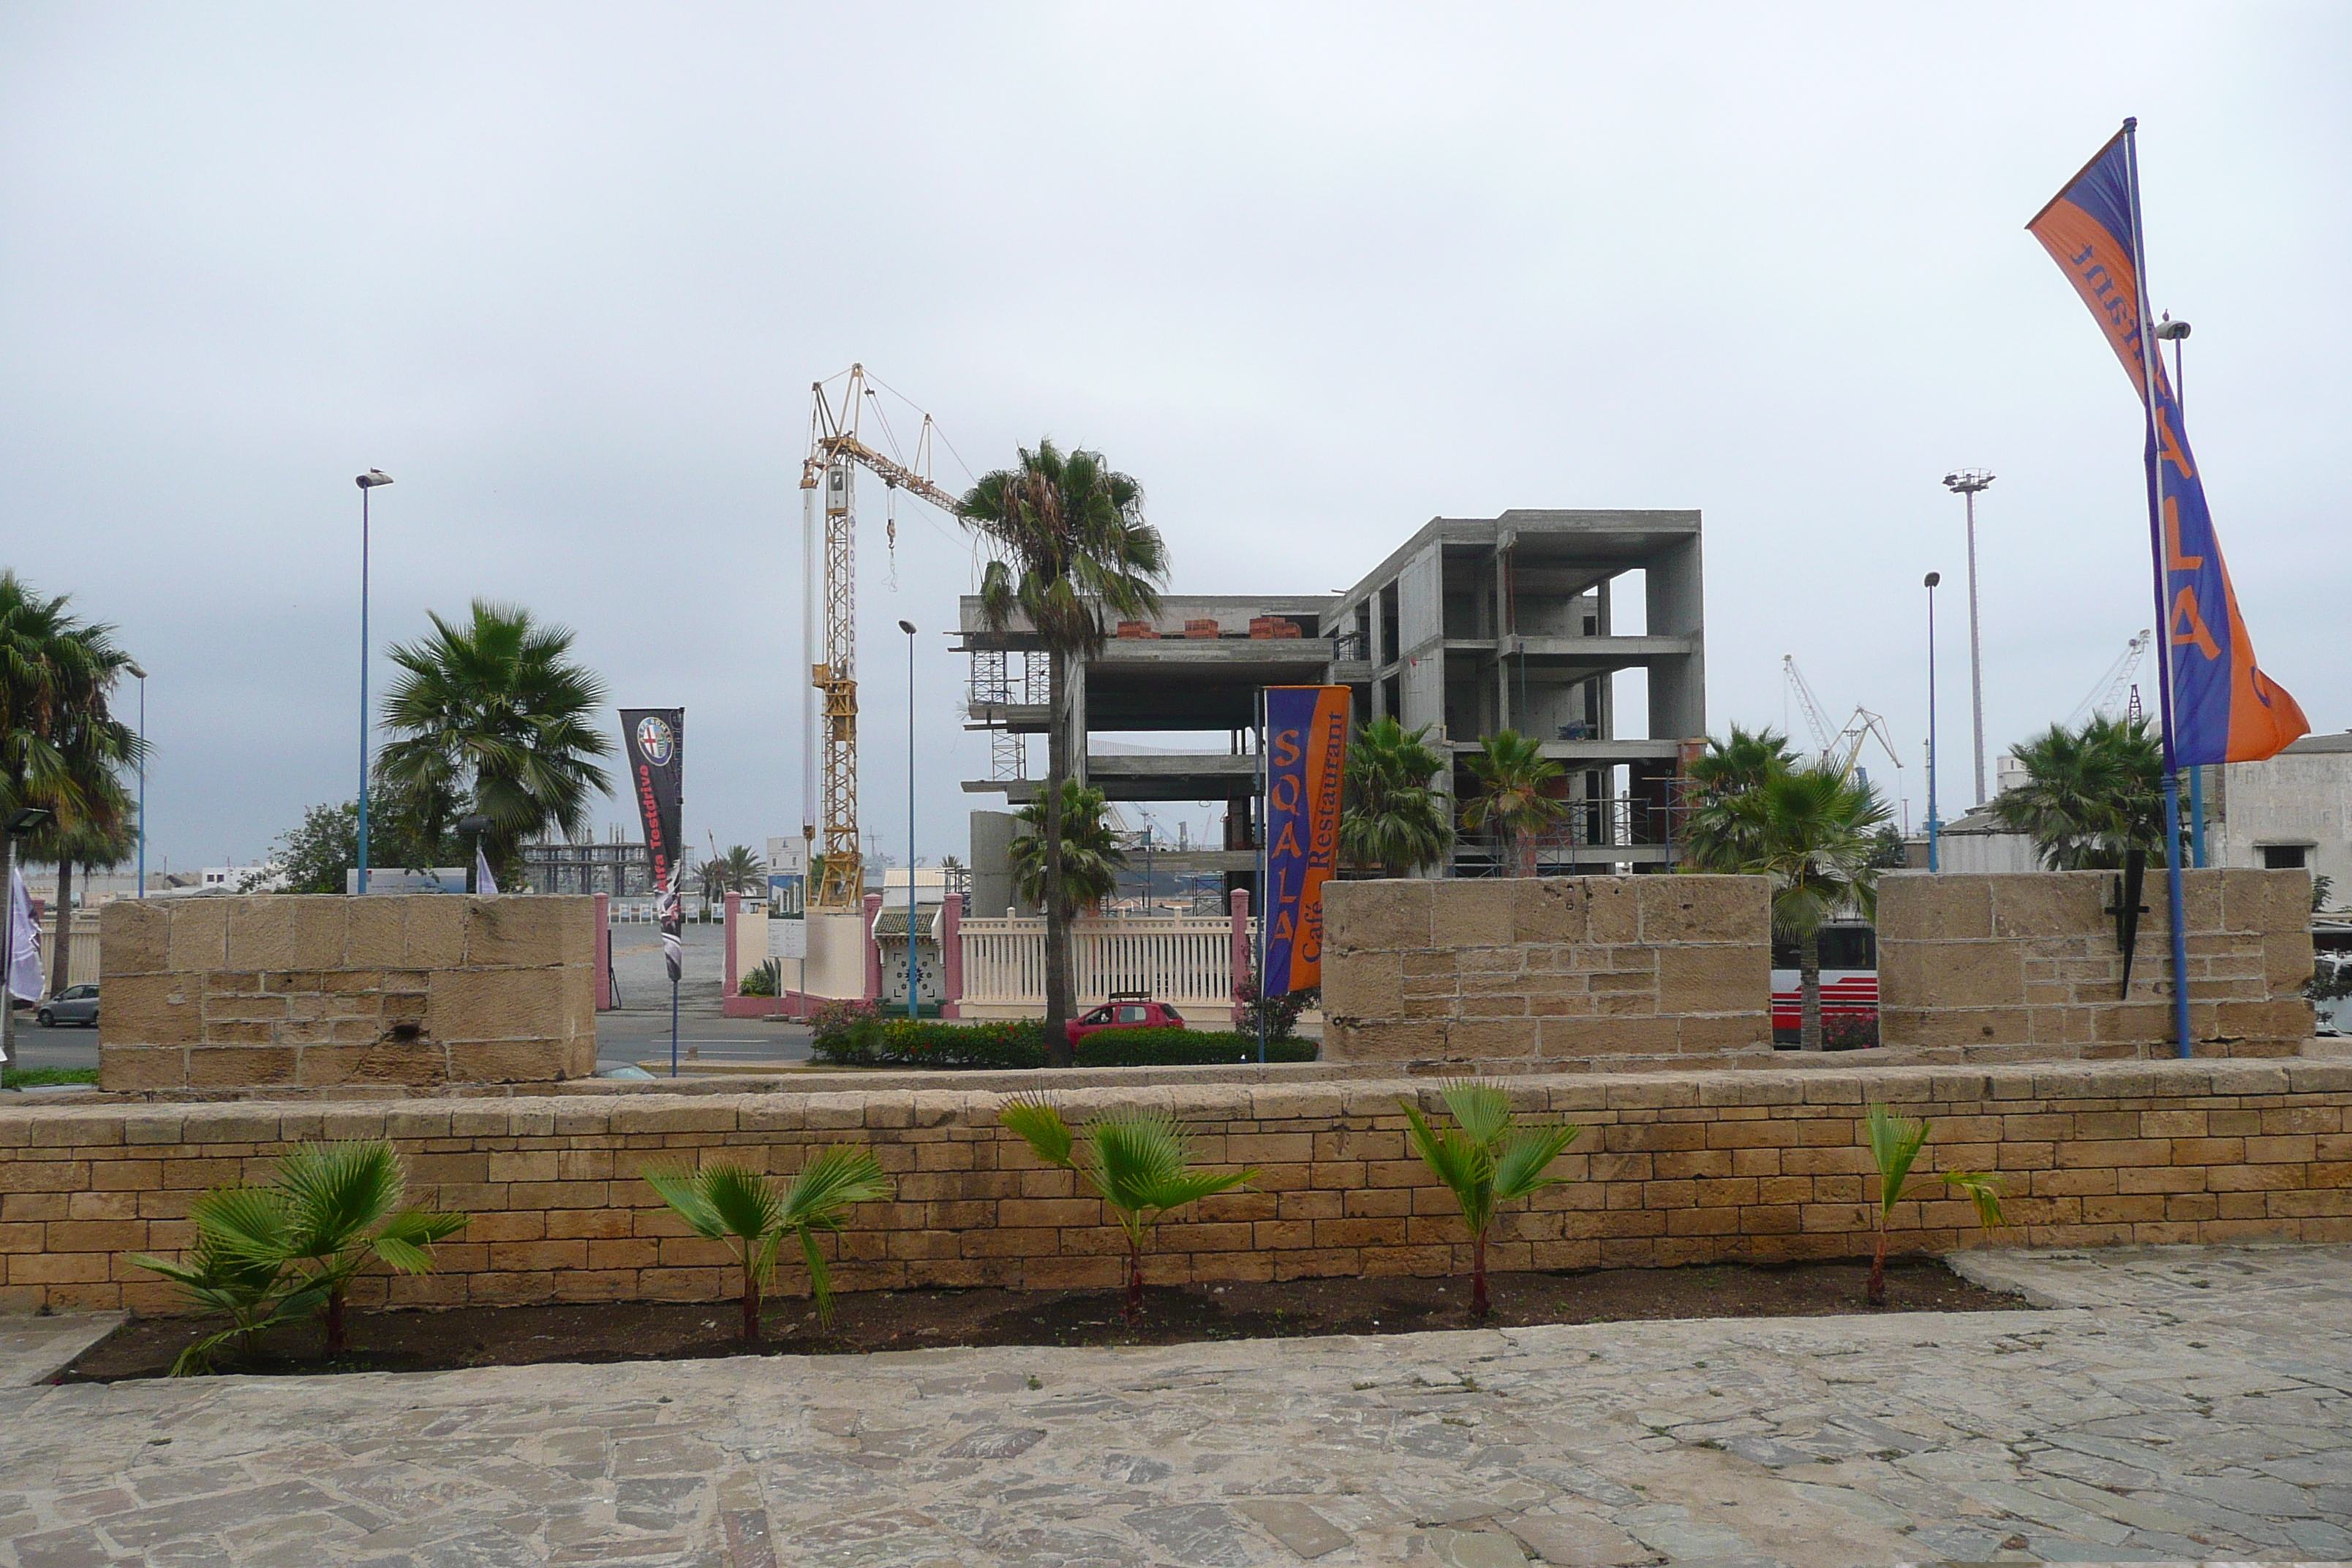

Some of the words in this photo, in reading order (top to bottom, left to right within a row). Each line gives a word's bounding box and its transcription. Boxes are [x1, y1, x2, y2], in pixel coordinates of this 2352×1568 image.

[640, 765, 662, 849] Testdrive
[1308, 712, 1343, 870] Restaurant
[655, 855, 668, 892] Alfa
[1270, 729, 1303, 950] SQALA
[1302, 902, 1323, 963] Café
